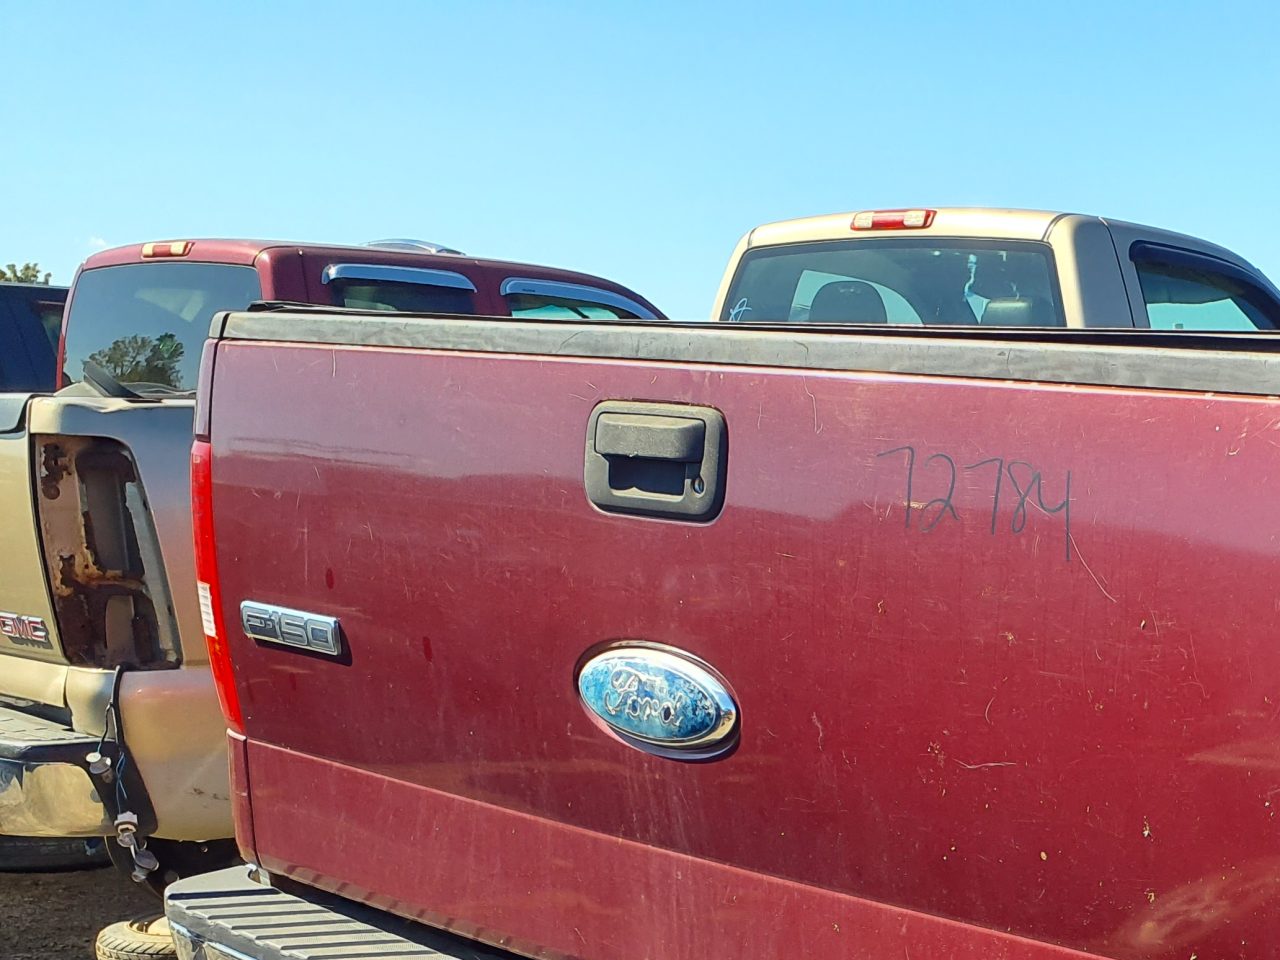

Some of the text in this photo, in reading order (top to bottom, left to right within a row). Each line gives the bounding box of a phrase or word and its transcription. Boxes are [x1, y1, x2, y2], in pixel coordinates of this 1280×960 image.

[876, 445, 1071, 561] 72784
[0, 612, 47, 642] GMC
[603, 666, 684, 727] Ford
